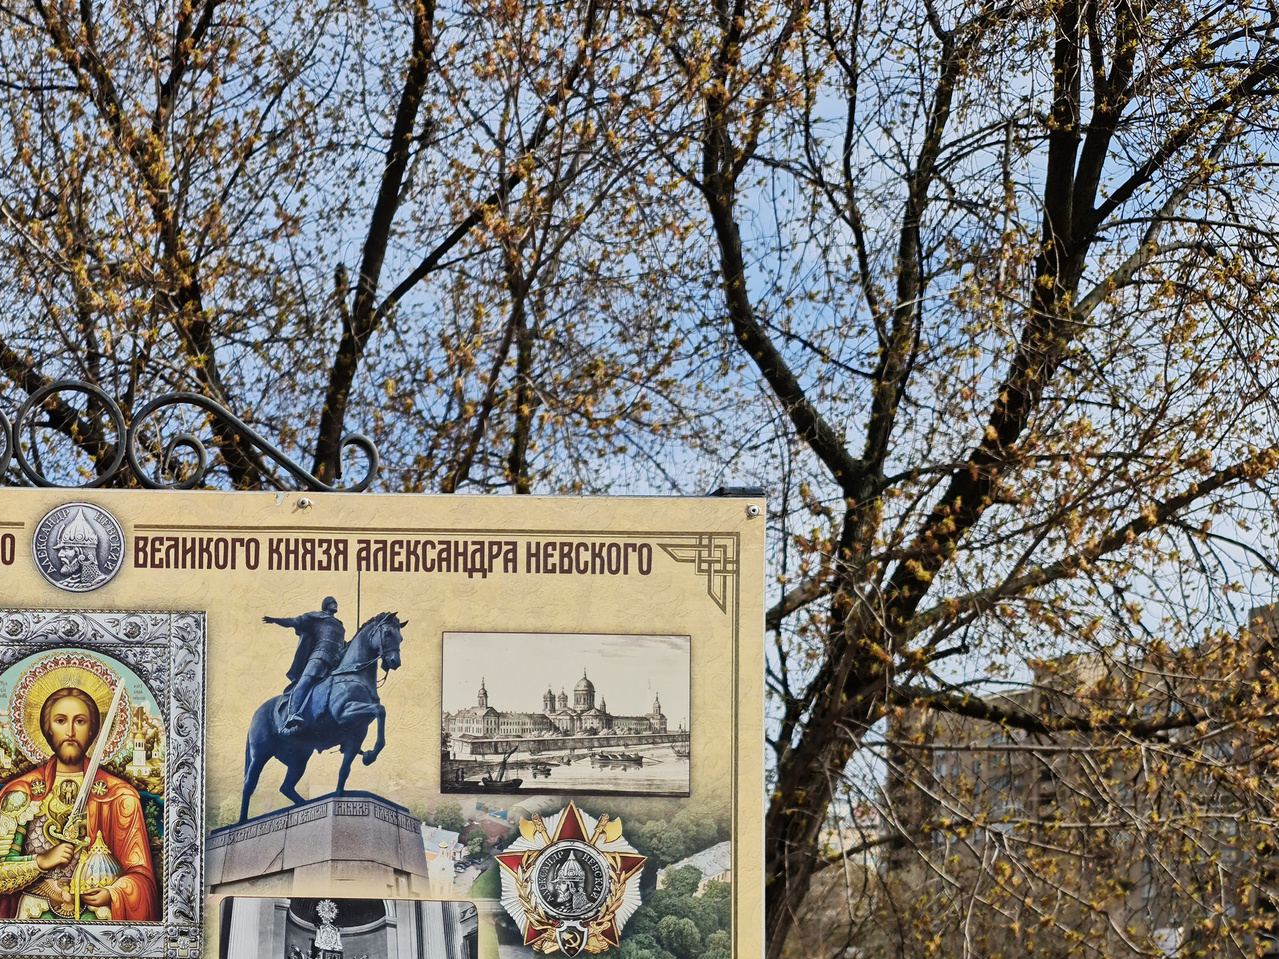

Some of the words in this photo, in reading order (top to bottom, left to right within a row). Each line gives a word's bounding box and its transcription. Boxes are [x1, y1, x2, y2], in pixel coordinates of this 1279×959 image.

[133, 535, 260, 570] ВЕЛИКОГО
[267, 537, 348, 571] КНЯЗЯ
[355, 538, 518, 579] АЛЕКСАНДРА
[525, 540, 652, 575] НЕВСКОГО
